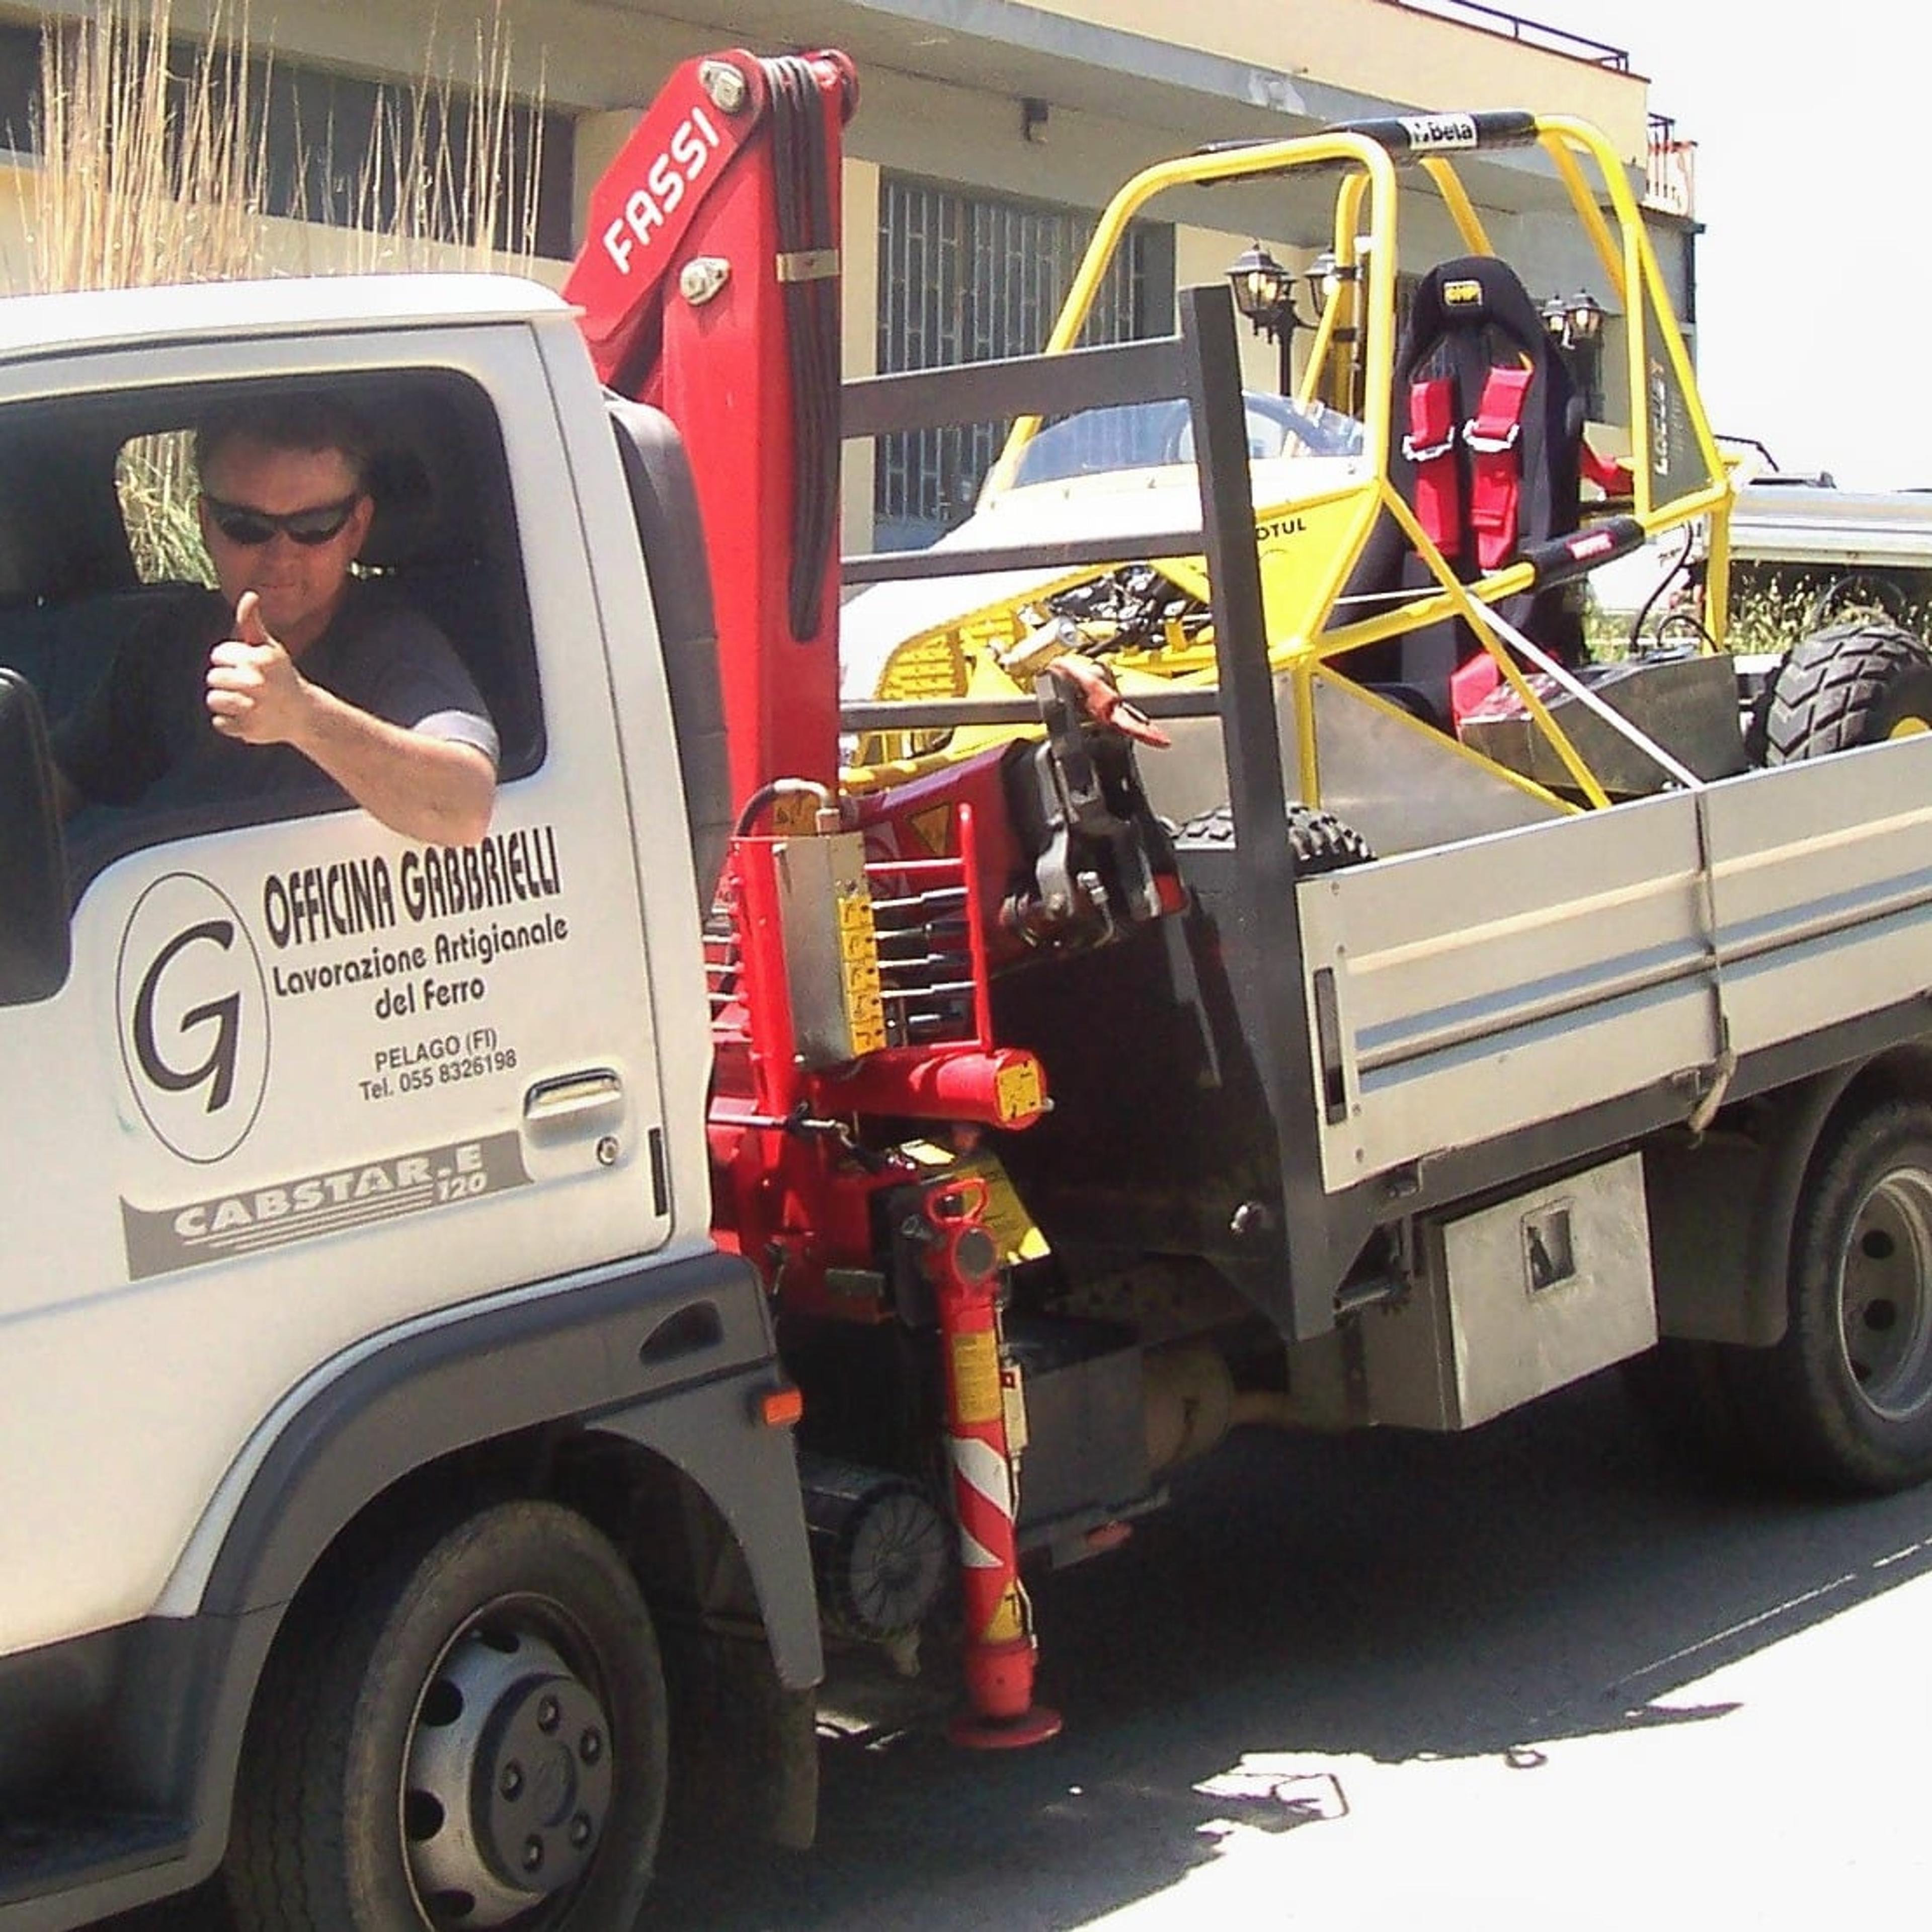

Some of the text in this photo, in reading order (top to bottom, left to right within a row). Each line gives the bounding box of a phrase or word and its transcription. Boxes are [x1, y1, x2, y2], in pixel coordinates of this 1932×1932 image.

[603, 107, 719, 274] FASSI
[1255, 518, 1307, 540] OTUL
[264, 826, 560, 948] OFFICINA GABBRIELLI
[273, 914, 569, 996] Lavorazione Artigianale
[133, 920, 240, 1113] G
[375, 976, 485, 1020] del Ferro
[359, 1048, 517, 1100] Tel. 055 8326198
[375, 1028, 497, 1072] PELAGO (FI)
[437, 1172, 487, 1201] 120
